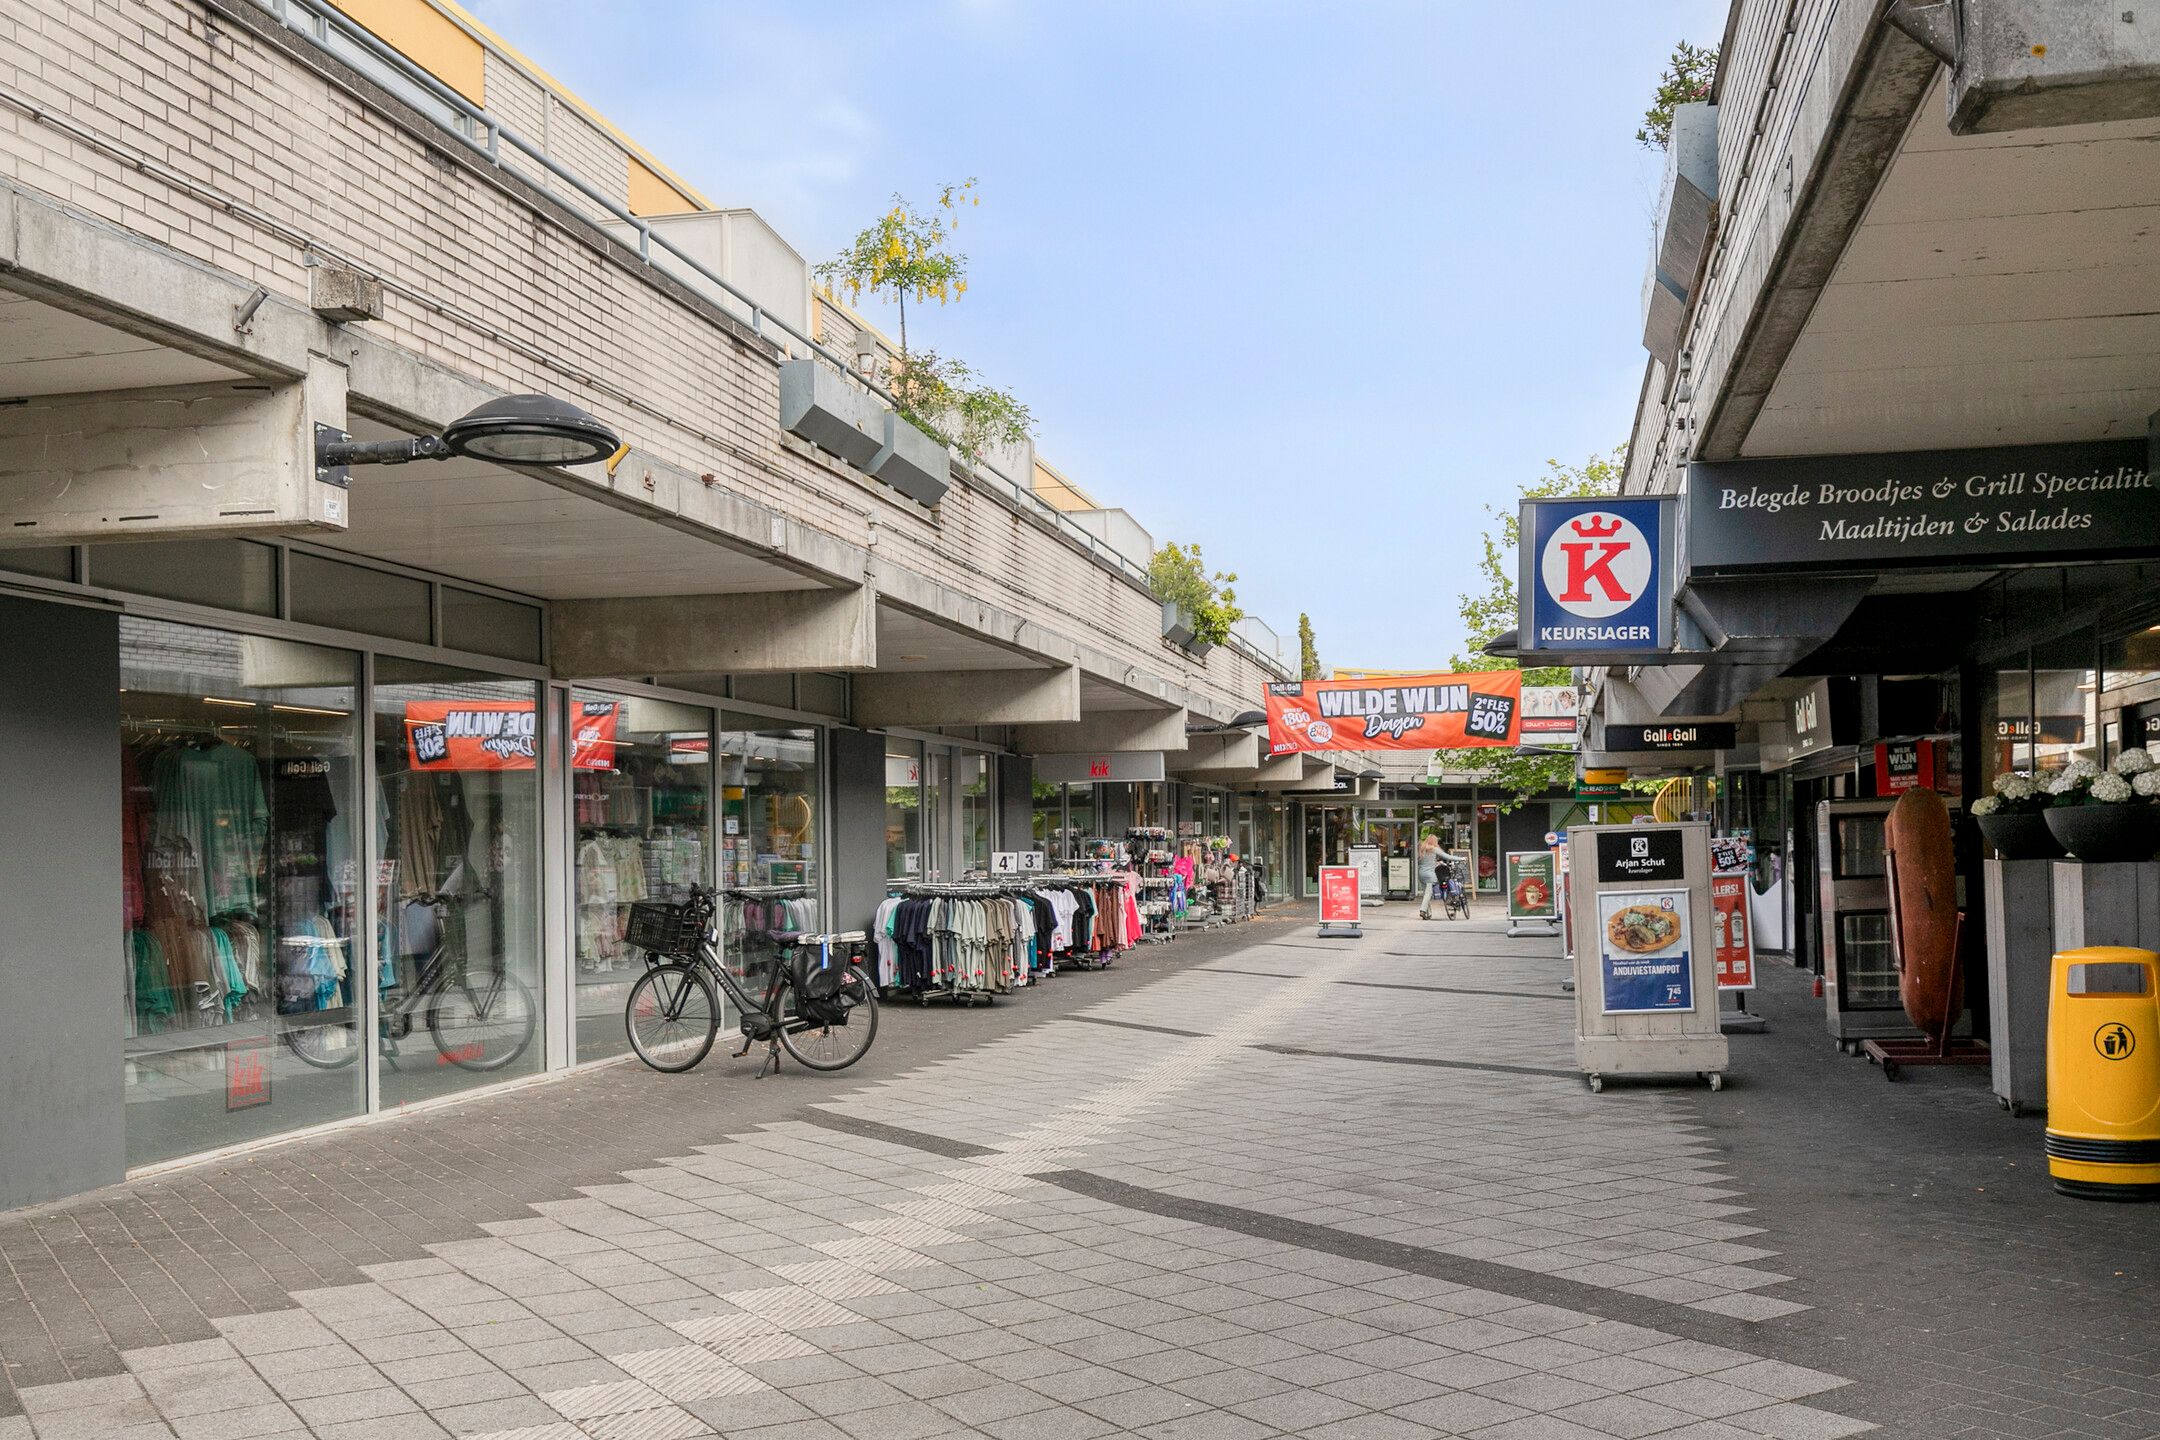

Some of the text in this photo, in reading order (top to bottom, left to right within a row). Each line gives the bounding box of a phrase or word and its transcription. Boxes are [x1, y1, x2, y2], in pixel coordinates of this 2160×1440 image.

[1719, 484, 1810, 512] Belegde
[1817, 479, 1923, 506] Broodjes
[1932, 477, 1957, 498] &
[1965, 472, 2026, 497] Grill
[1818, 507, 2092, 542] Maaltijden & Salades
[1560, 542, 1631, 602] K
[1541, 626, 1650, 641] KEURSLAGER
[1319, 685, 1468, 717] WILDE WIJN
[1487, 699, 1510, 712] FLES
[1281, 711, 1310, 726] 1800
[1365, 714, 1424, 738] Dagen
[1470, 710, 1507, 734] 50%
[1643, 728, 1697, 742] Gall&Gall
[1889, 752, 1917, 765] WIJN
[1090, 761, 1109, 776] kik
[1615, 858, 1665, 869] Arjan Schut
[1613, 964, 1680, 977] ANDIJVIESTAMPPOT
